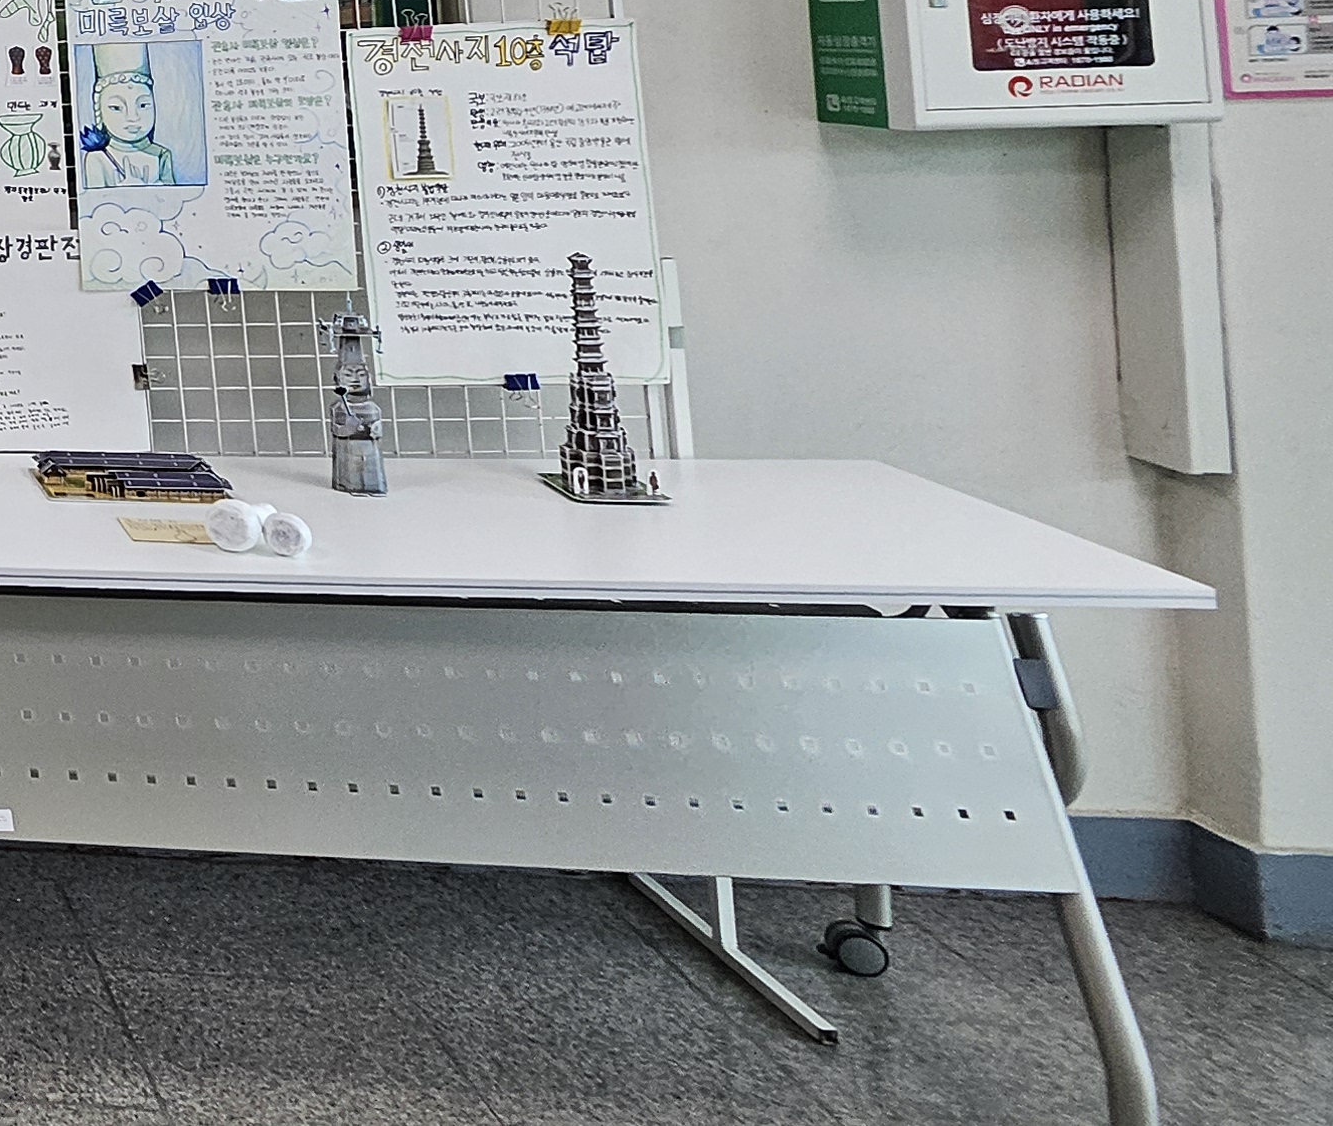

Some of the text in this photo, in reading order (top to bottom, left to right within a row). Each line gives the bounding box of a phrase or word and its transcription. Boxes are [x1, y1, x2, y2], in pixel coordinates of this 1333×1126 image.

[77, 2, 235, 36] 미륵보살 입상
[1077, 7, 1141, 21] 사용하세요!
[548, 30, 619, 66] 석탑
[1039, 73, 1124, 89] RADIAN
